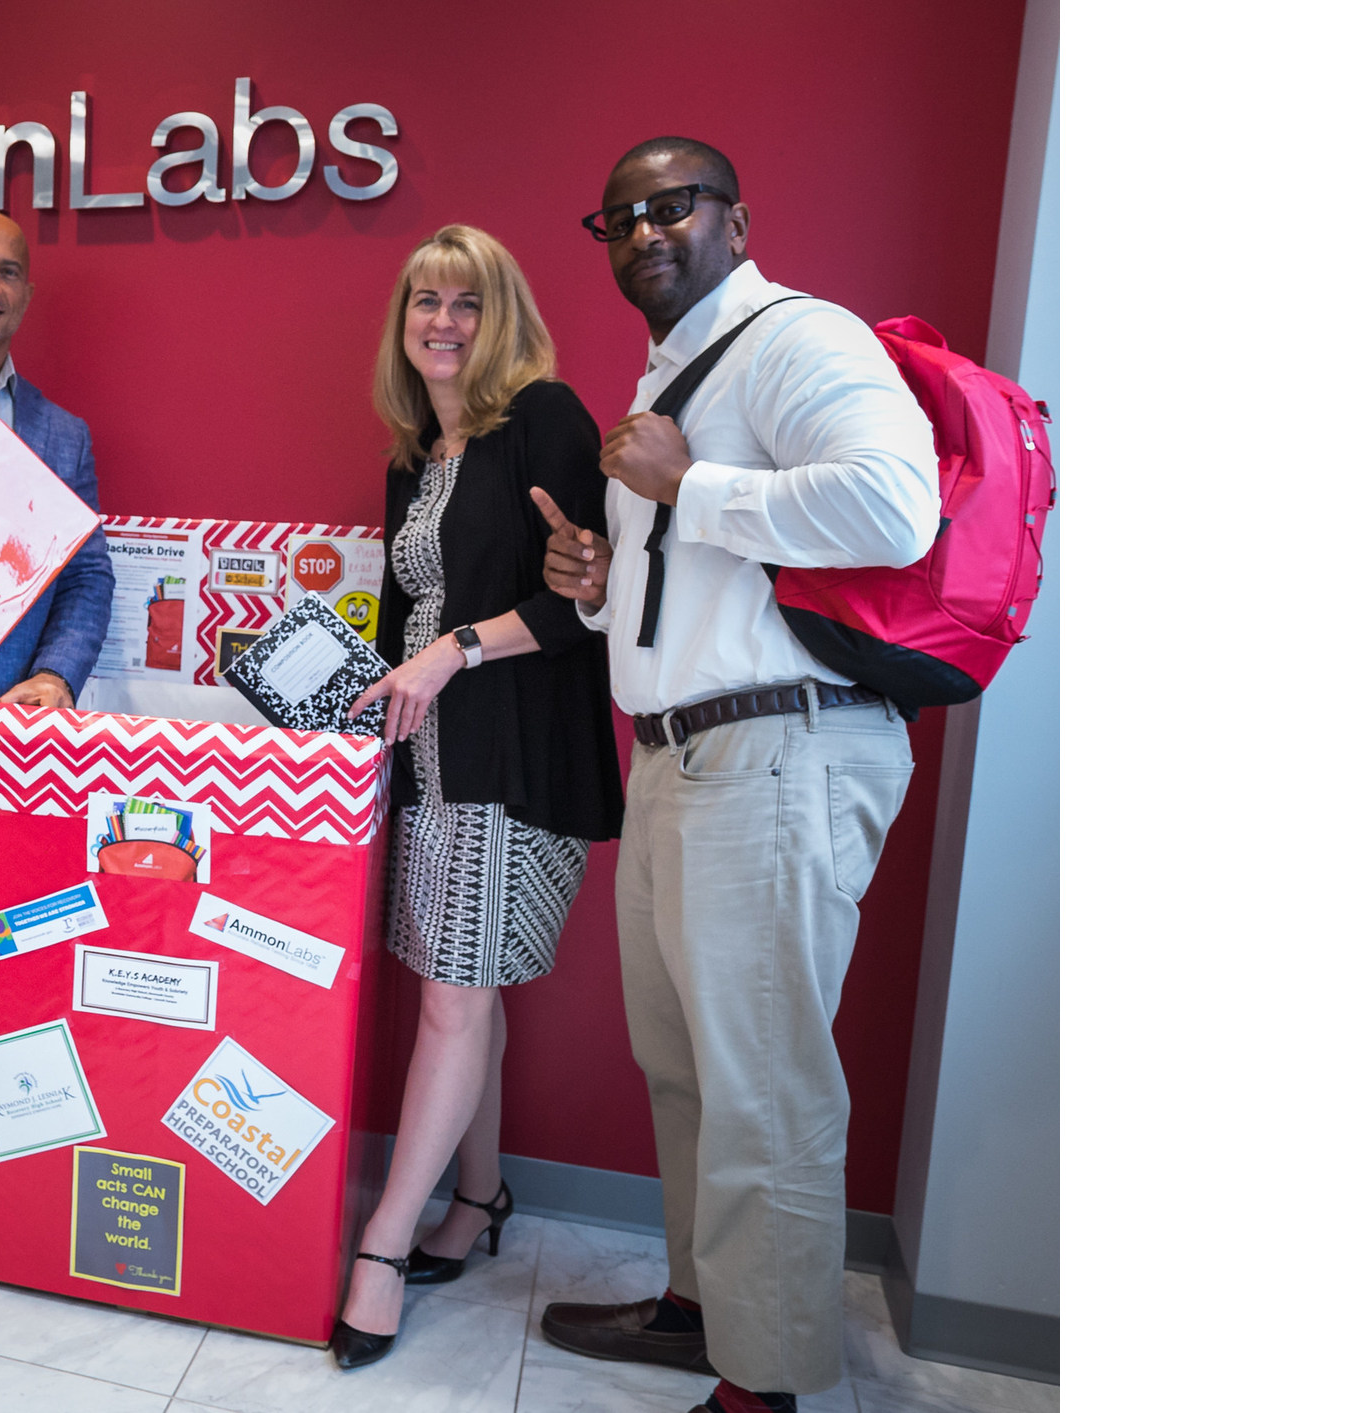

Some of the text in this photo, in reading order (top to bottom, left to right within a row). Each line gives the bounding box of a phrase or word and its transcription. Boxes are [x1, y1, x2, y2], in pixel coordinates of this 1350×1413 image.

[157, 547, 185, 557] Drive
[218, 557, 265, 572] Back
[299, 558, 335, 574] STOP
[299, 631, 314, 645] BOOK
[141, 974, 182, 986] ACADEMY
[37, 1086, 76, 1100] LESNIAK
[193, 1078, 301, 1172] Coastal
[177, 1100, 279, 1184] PREPARATORY
[167, 1112, 267, 1198] HIGH SCHOOL
[111, 1163, 152, 1181] Small
[96, 1179, 166, 1200] acts CAN
[102, 1196, 159, 1217] change
[118, 1215, 141, 1230] the
[105, 1232, 152, 1250] world.
[128, 1265, 158, 1279] Thank
